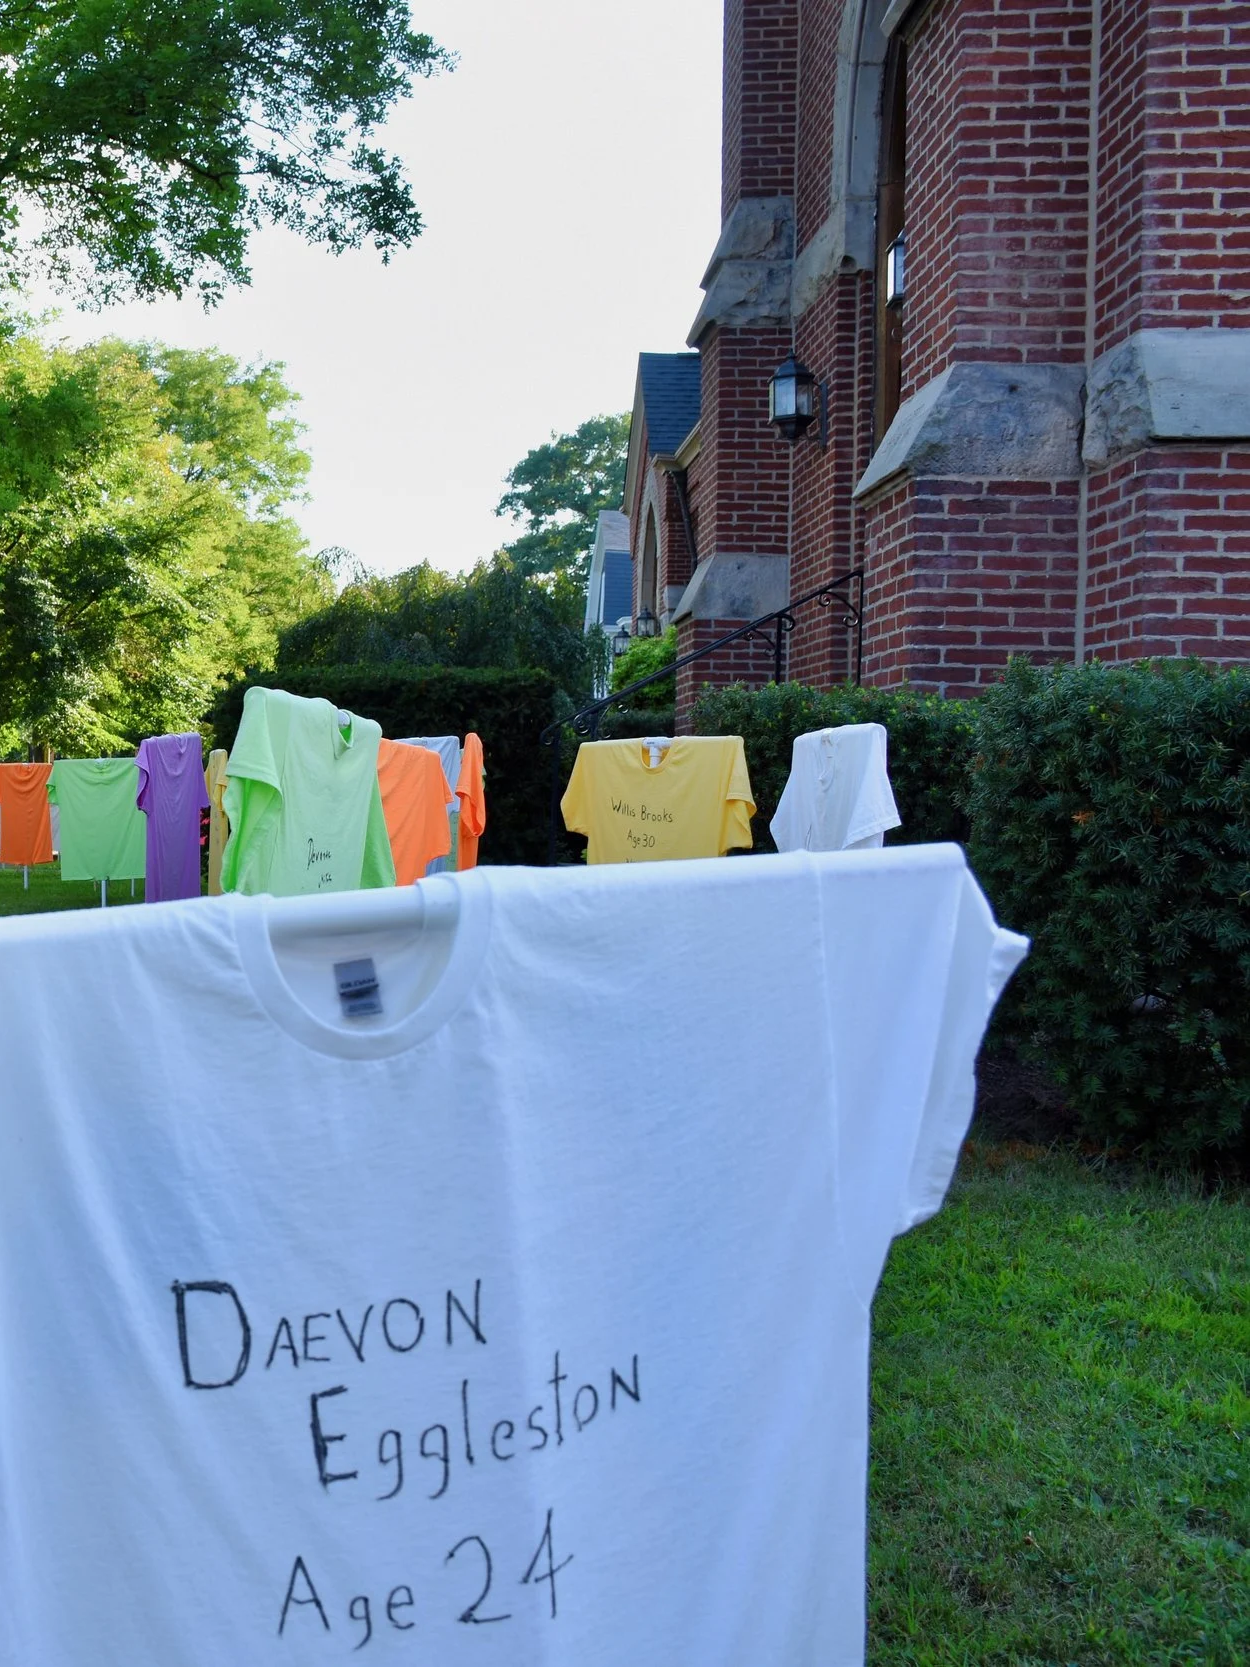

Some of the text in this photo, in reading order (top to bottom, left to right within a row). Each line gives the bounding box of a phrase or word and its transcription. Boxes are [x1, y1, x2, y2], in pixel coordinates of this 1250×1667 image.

[611, 796, 673, 823] Willis Brooks
[627, 829, 655, 848] Age 30
[278, 1507, 575, 1650] Age 24
